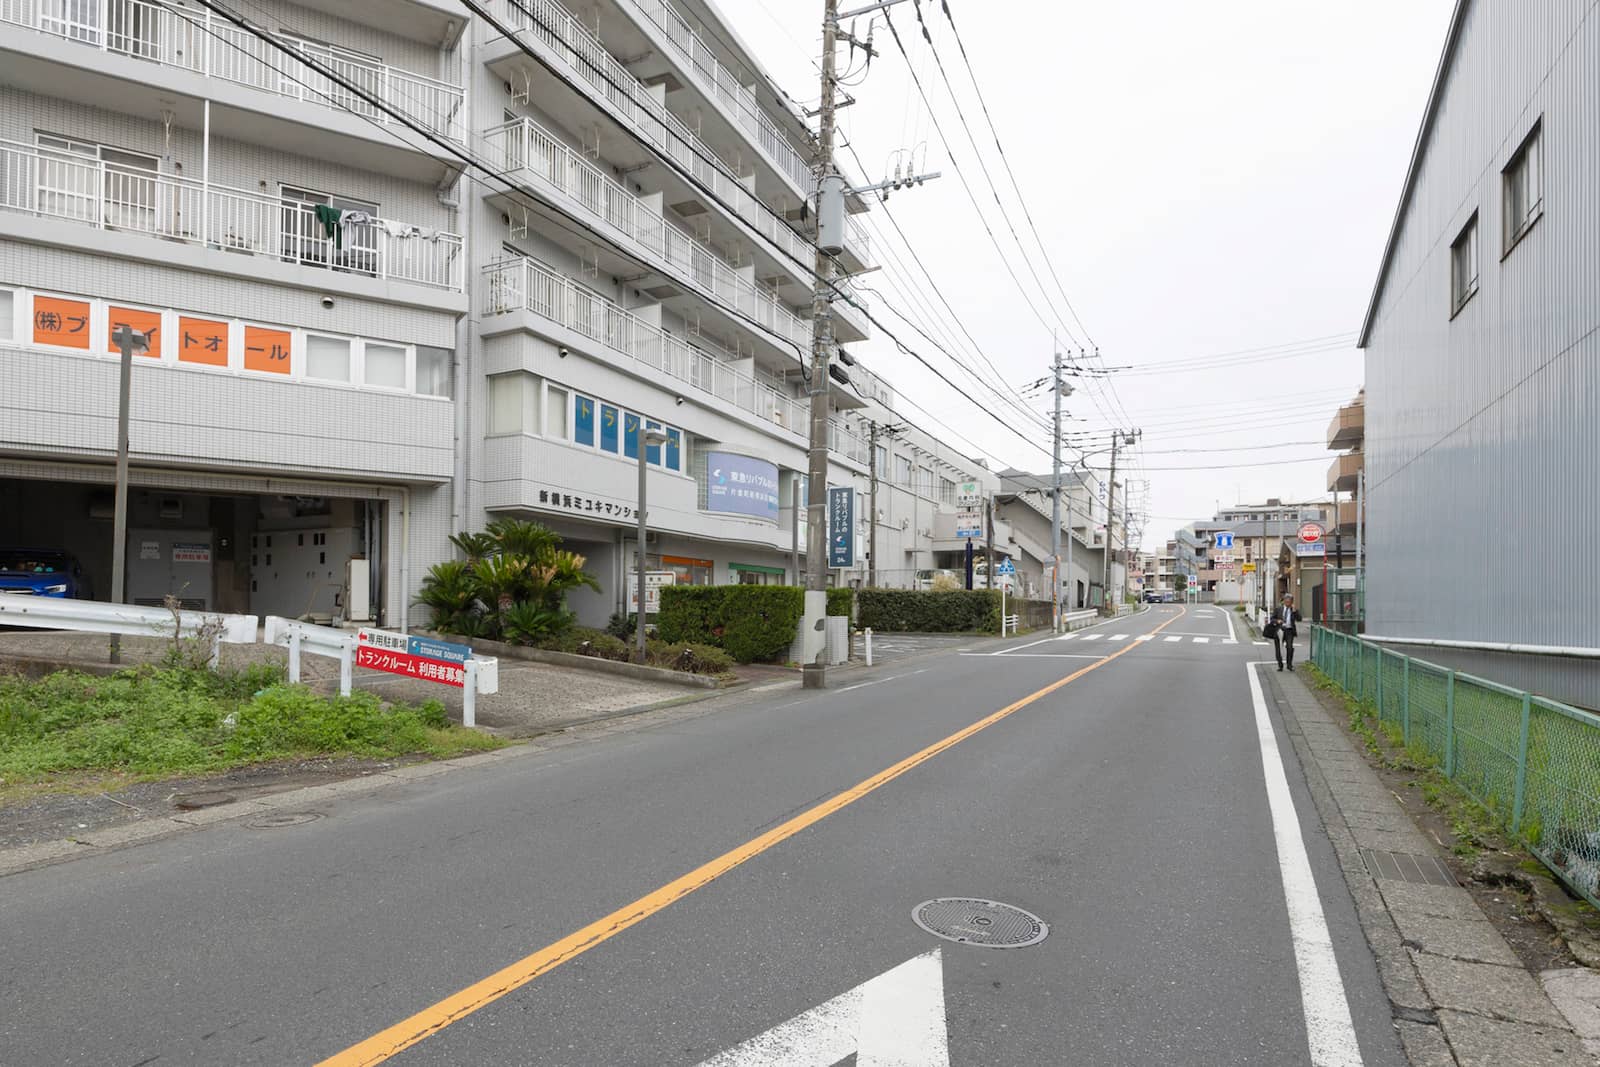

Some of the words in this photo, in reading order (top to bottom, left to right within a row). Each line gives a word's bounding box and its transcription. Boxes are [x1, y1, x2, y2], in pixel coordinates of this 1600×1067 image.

[539, 490, 649, 519] 新横浜ミユキマンショ
[367, 632, 407, 651] 専用駐車場
[358, 650, 416, 673] トランクルーム
[418, 661, 464, 683] 利用者募集
